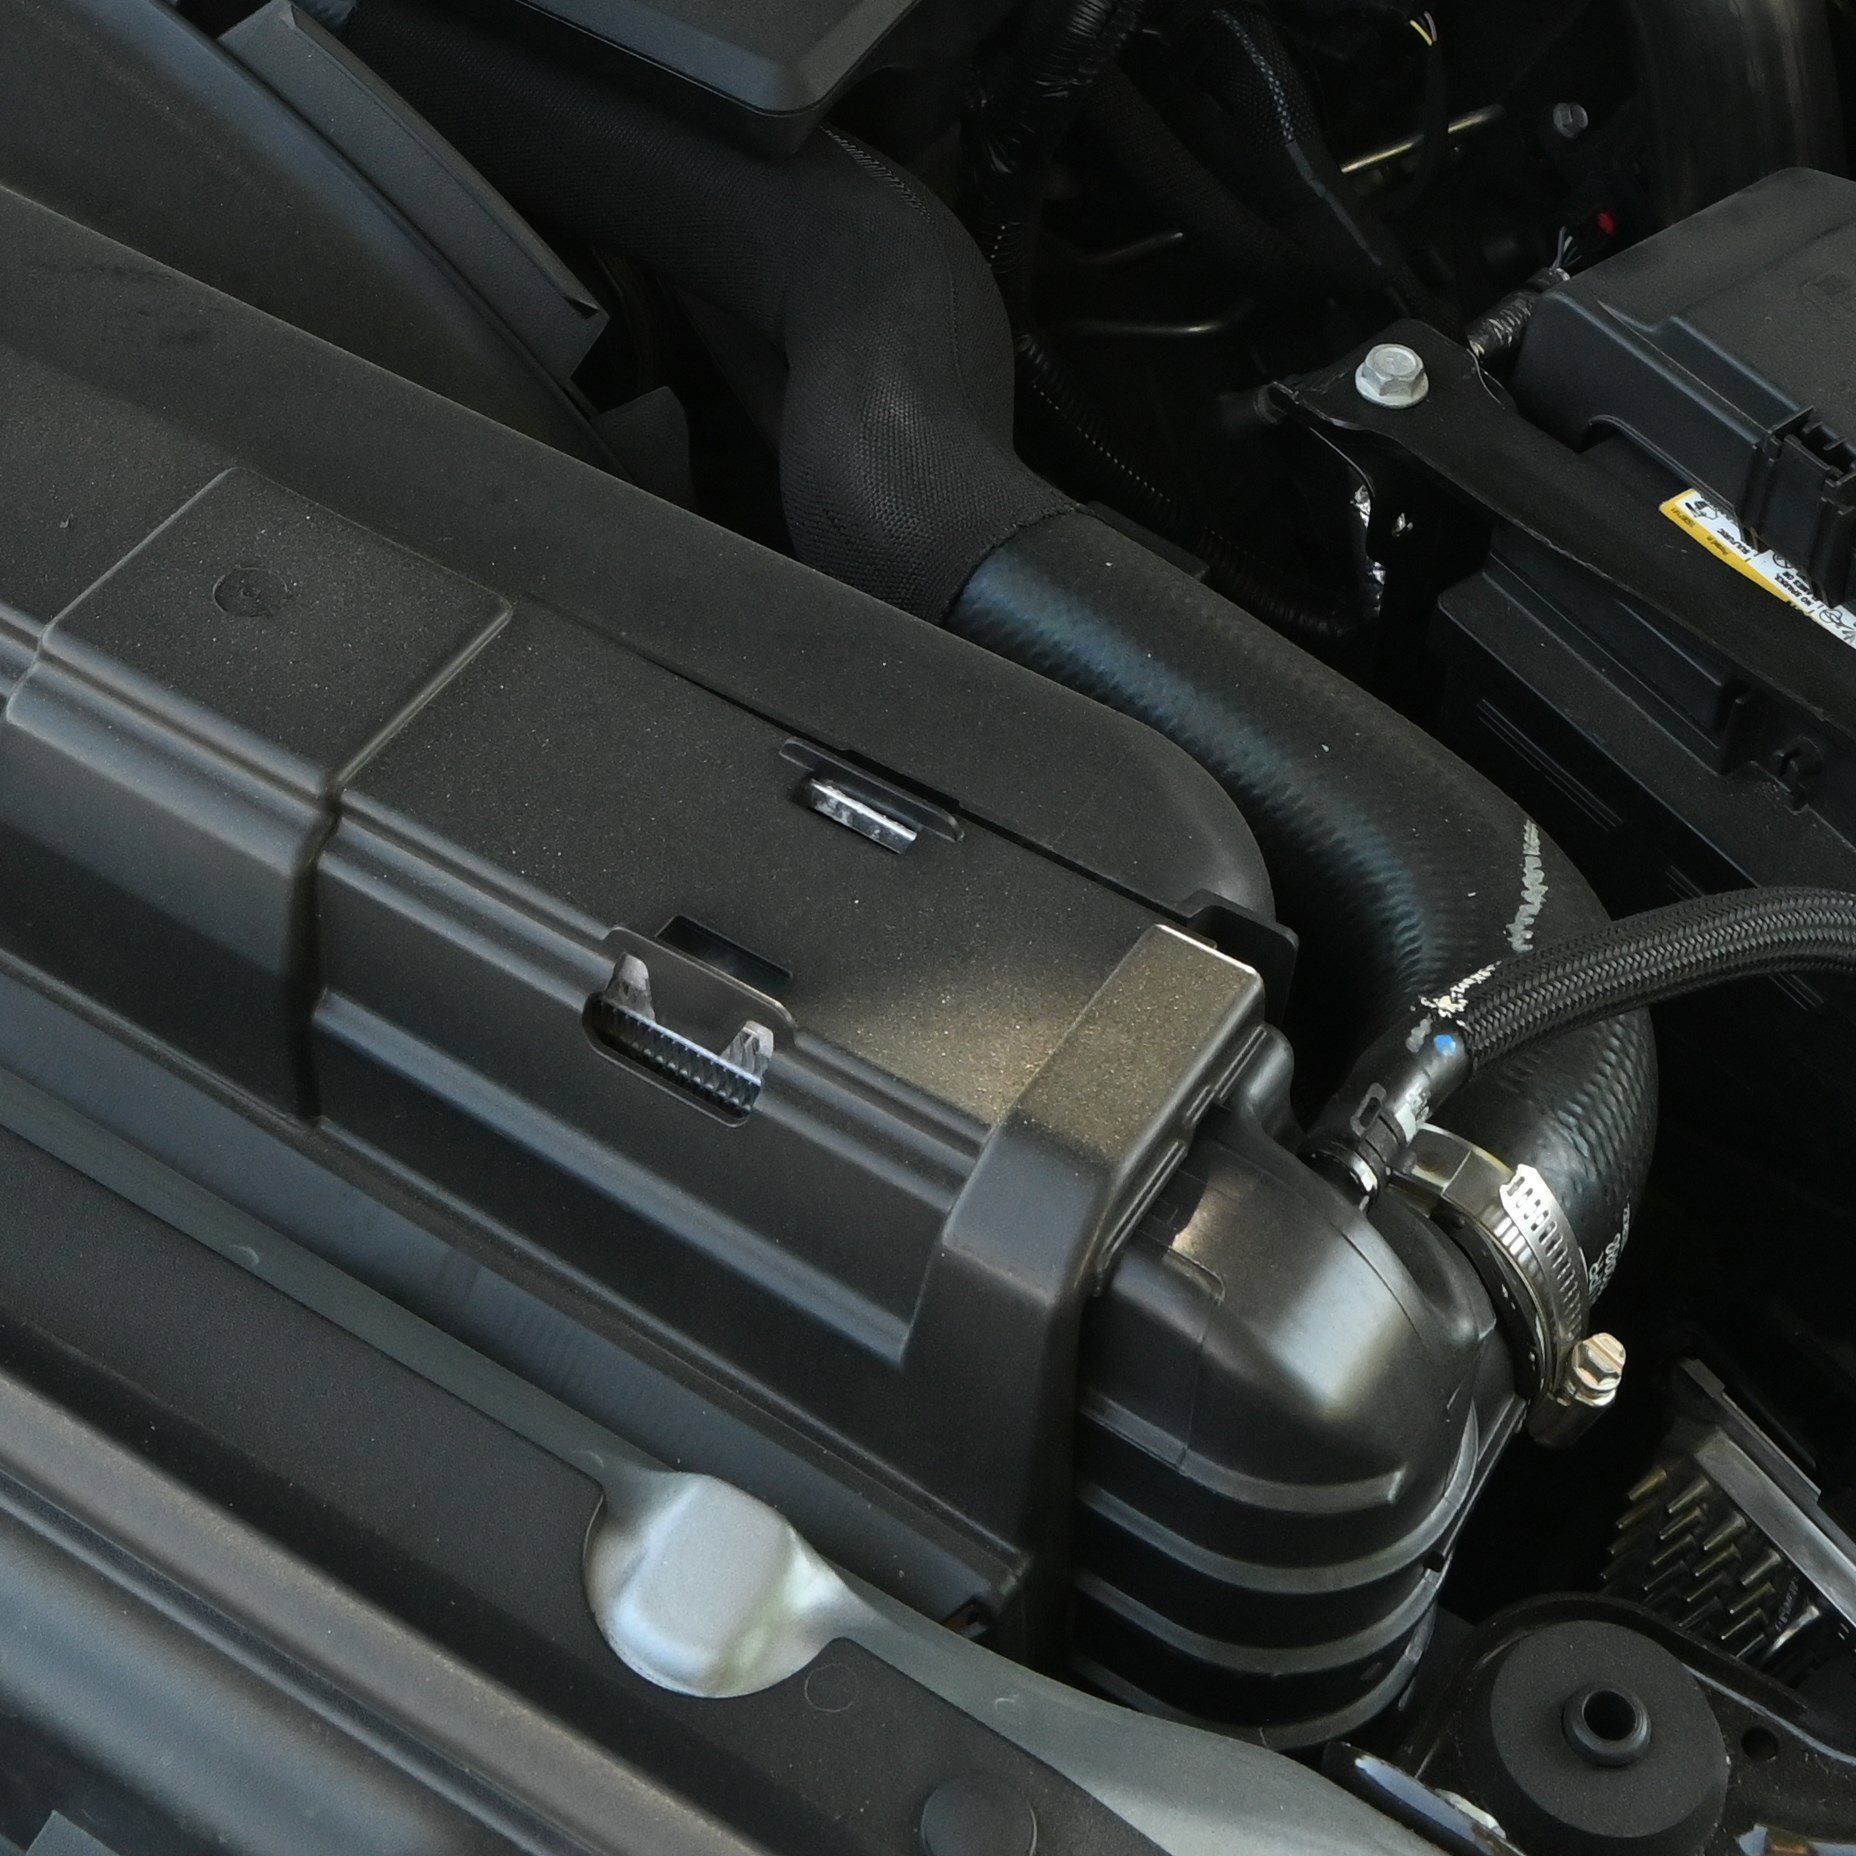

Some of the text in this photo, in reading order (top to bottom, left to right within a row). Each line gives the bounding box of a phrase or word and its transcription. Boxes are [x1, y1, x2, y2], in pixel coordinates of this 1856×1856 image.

[1716, 527, 1751, 556] SULFURIC
[1781, 570, 1795, 581] OR
[1799, 596, 1814, 607] NO
